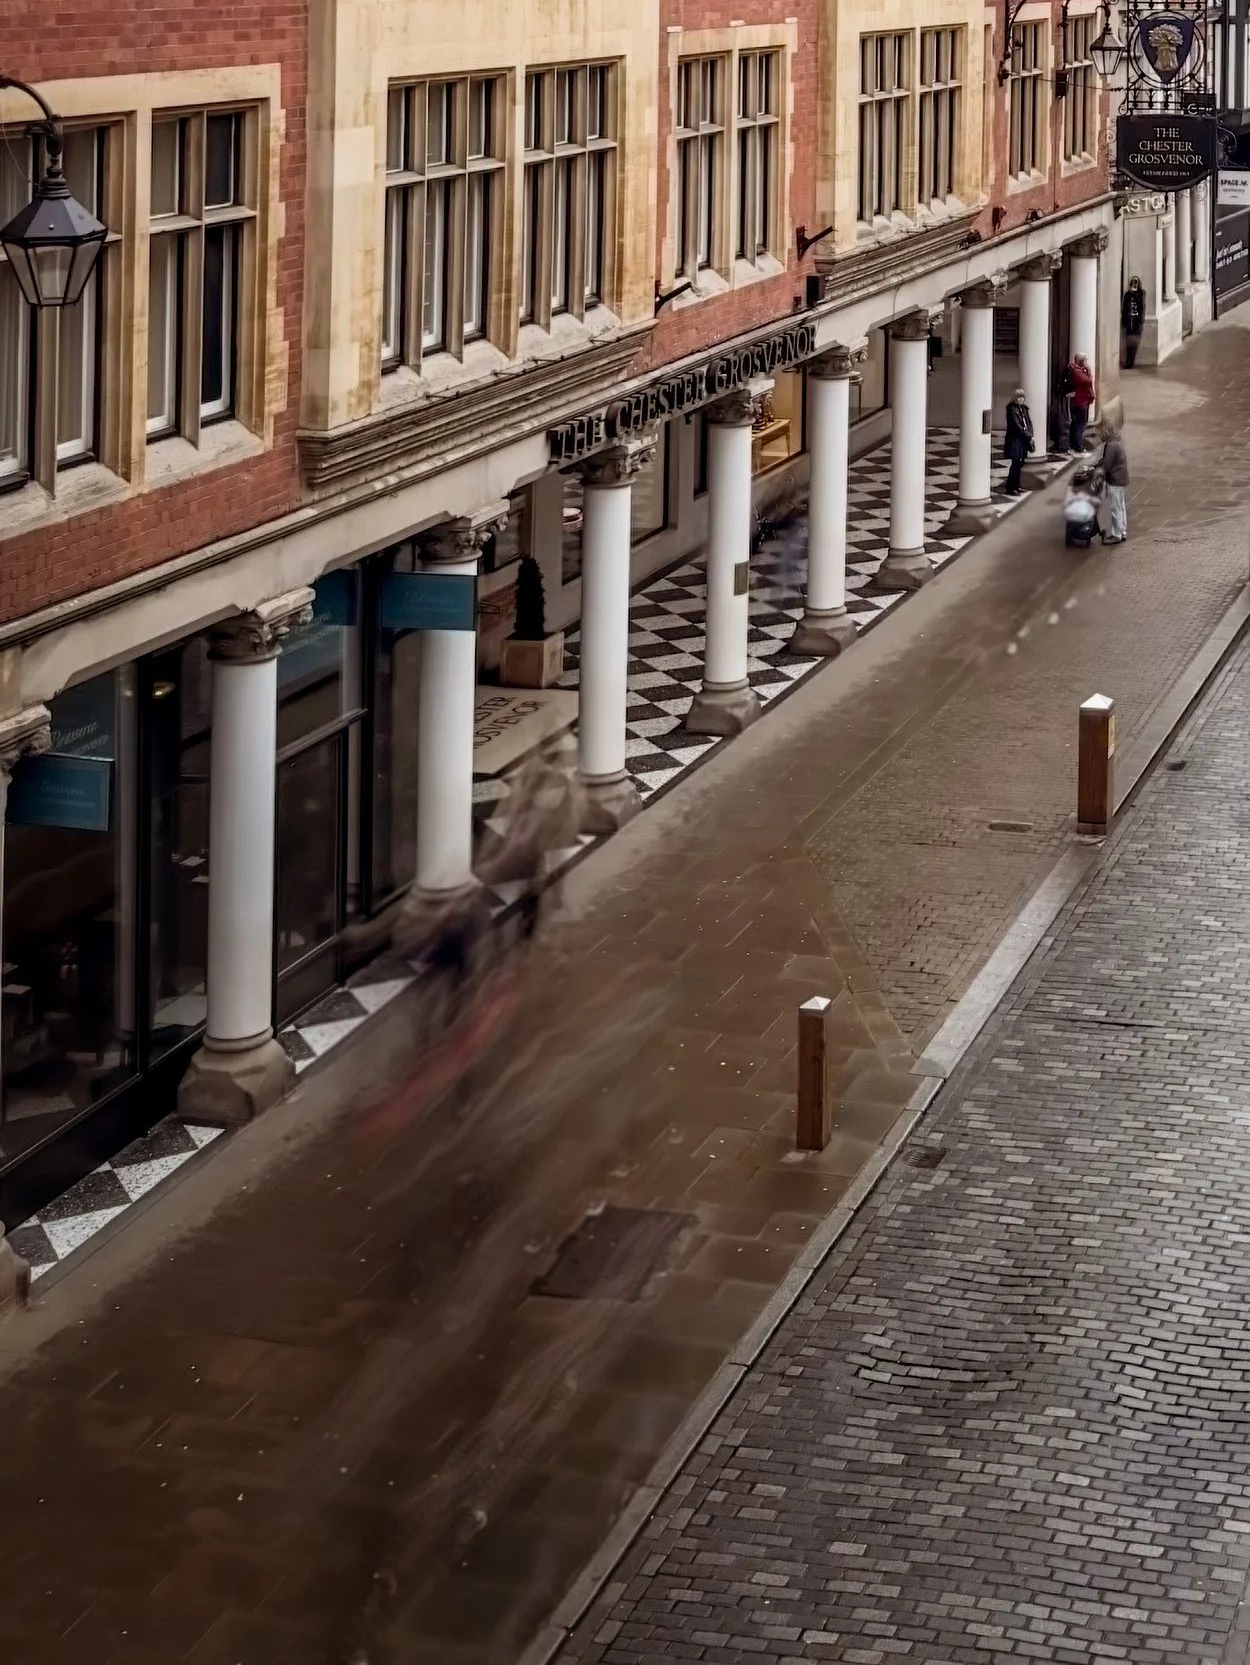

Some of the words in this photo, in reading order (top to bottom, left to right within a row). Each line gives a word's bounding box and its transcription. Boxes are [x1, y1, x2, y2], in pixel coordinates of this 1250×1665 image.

[1153, 127, 1180, 138] THE
[1138, 140, 1194, 152] CHESTER
[1128, 153, 1204, 166] GROSVENOR
[547, 412, 603, 465] THE
[604, 369, 707, 438] CHESTER
[706, 324, 817, 394] GROSVENOR
